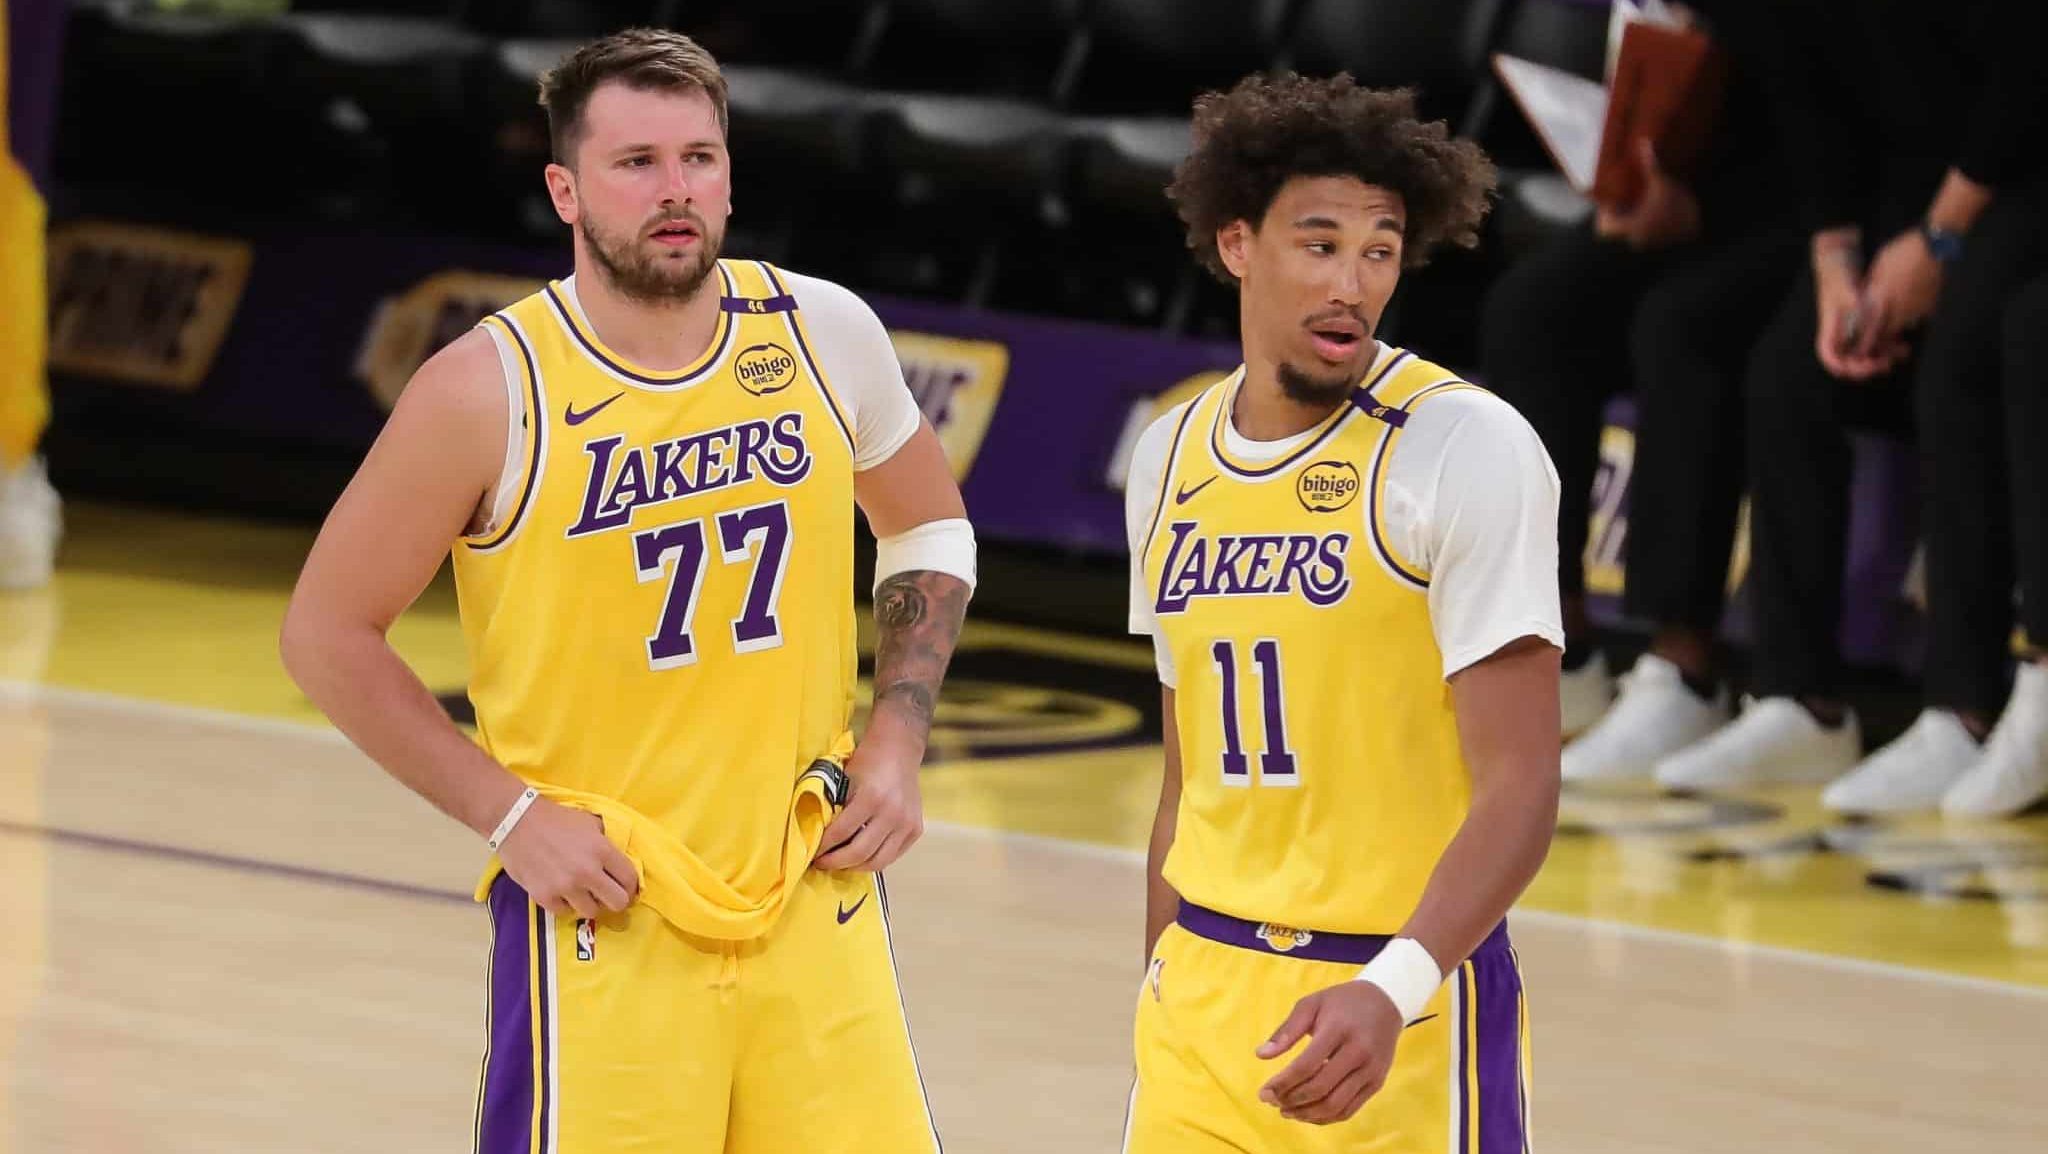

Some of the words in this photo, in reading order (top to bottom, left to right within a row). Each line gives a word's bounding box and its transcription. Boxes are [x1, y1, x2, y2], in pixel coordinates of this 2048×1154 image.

[739, 357, 791, 379] bibigo
[566, 414, 811, 537] LAKERS
[1303, 475, 1356, 497] bibigo
[632, 500, 792, 669] 77
[1155, 521, 1351, 615] LAKERS
[1210, 638, 1298, 786] 11
